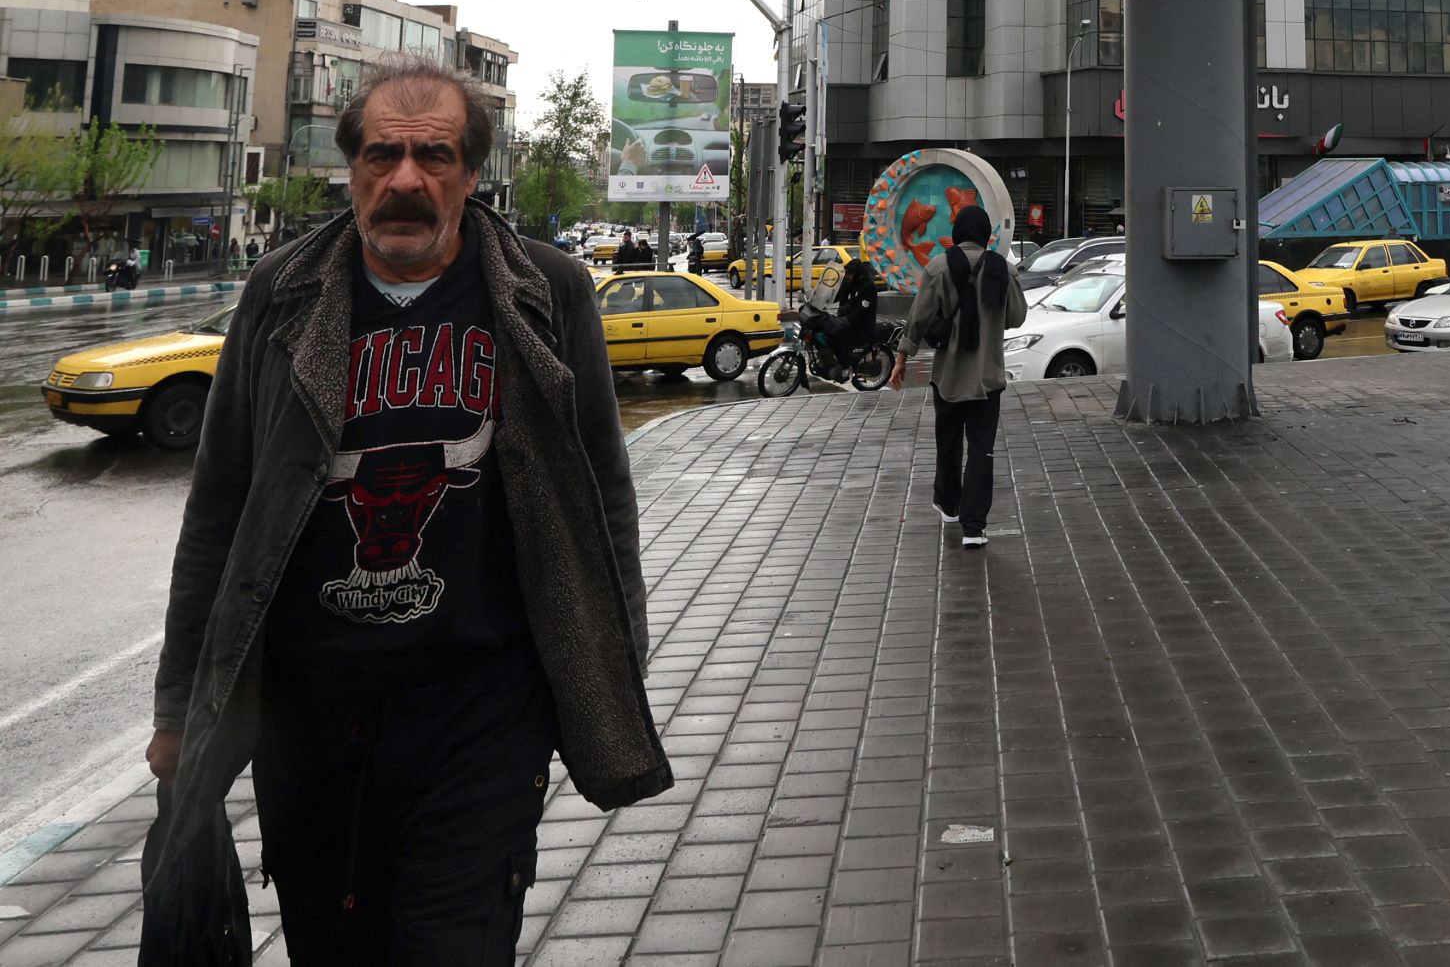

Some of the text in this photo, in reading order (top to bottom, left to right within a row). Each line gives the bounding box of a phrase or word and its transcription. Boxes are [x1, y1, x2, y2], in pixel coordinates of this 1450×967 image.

[674, 40, 697, 51] نگاه
[697, 41, 714, 55] جلو
[714, 43, 725, 55] به
[1256, 85, 1290, 121] بان
[336, 584, 429, 611] Windy City
